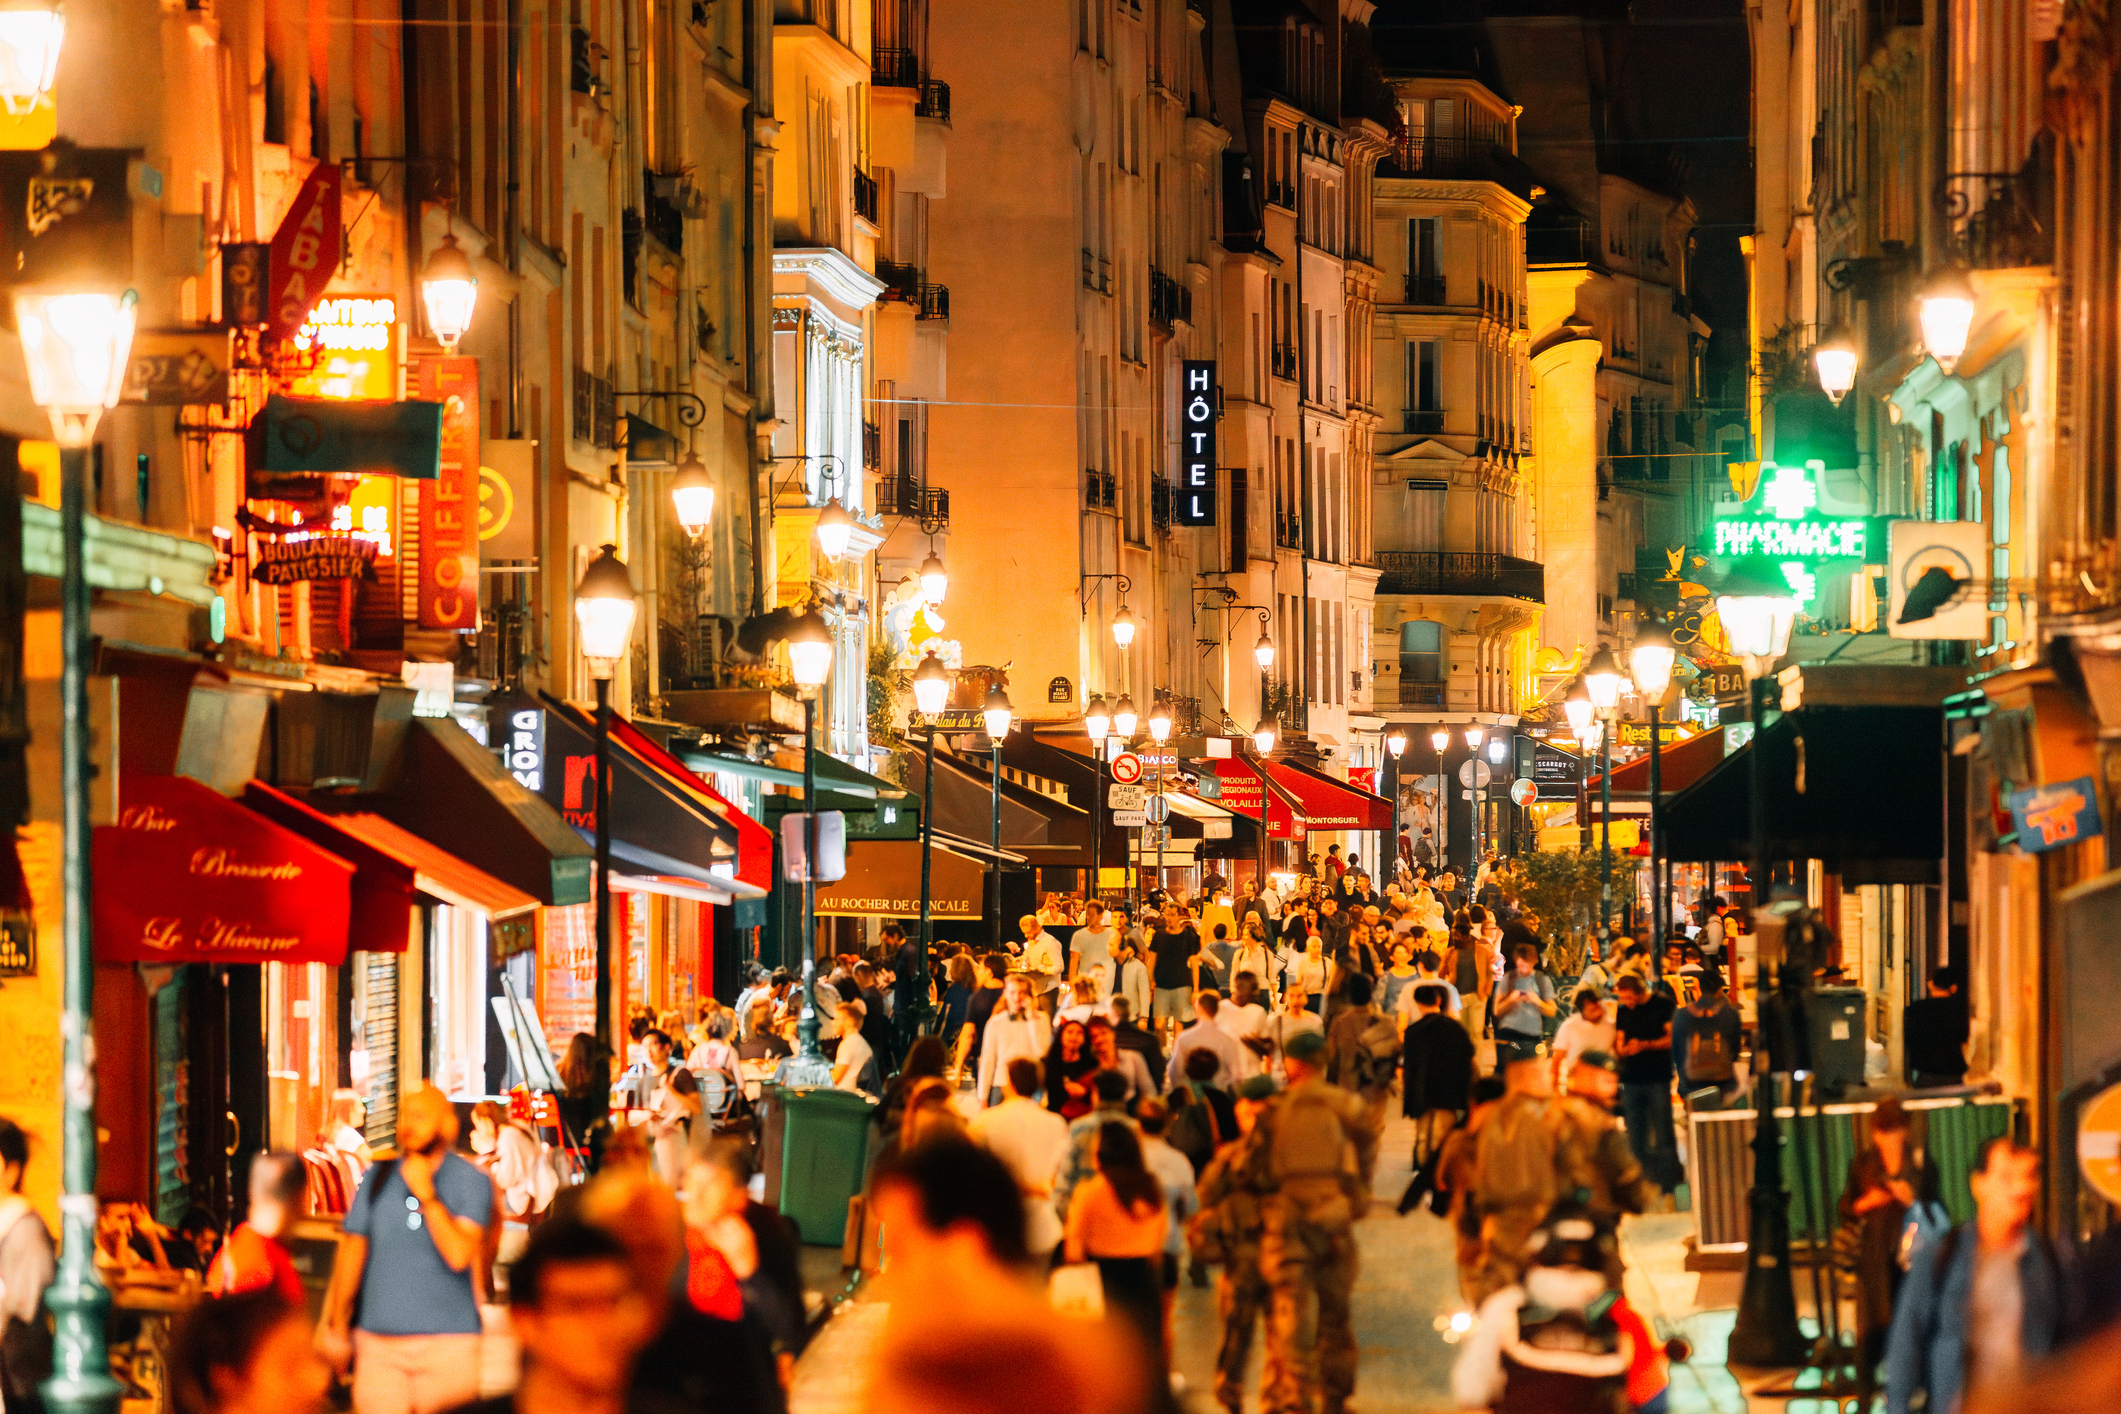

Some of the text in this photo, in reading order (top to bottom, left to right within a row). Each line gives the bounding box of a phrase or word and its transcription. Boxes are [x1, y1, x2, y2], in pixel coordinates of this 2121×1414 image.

[280, 180, 331, 325] TABAC
[1188, 369, 1209, 517] HÔTEL
[1716, 521, 1863, 556] PHARMACIE
[1719, 674, 1744, 691] BA
[957, 712, 971, 728] du
[512, 710, 541, 790] GROM
[1221, 777, 1256, 785] PRODUITS
[1118, 785, 1137, 793] SAUF
[1221, 786, 1262, 794] REGIONAUX
[1221, 799, 1271, 808] VOLAILLES
[1306, 816, 1360, 825] MONTORGUEIL
[821, 898, 970, 912] AU ROCHER DE CNCALE
